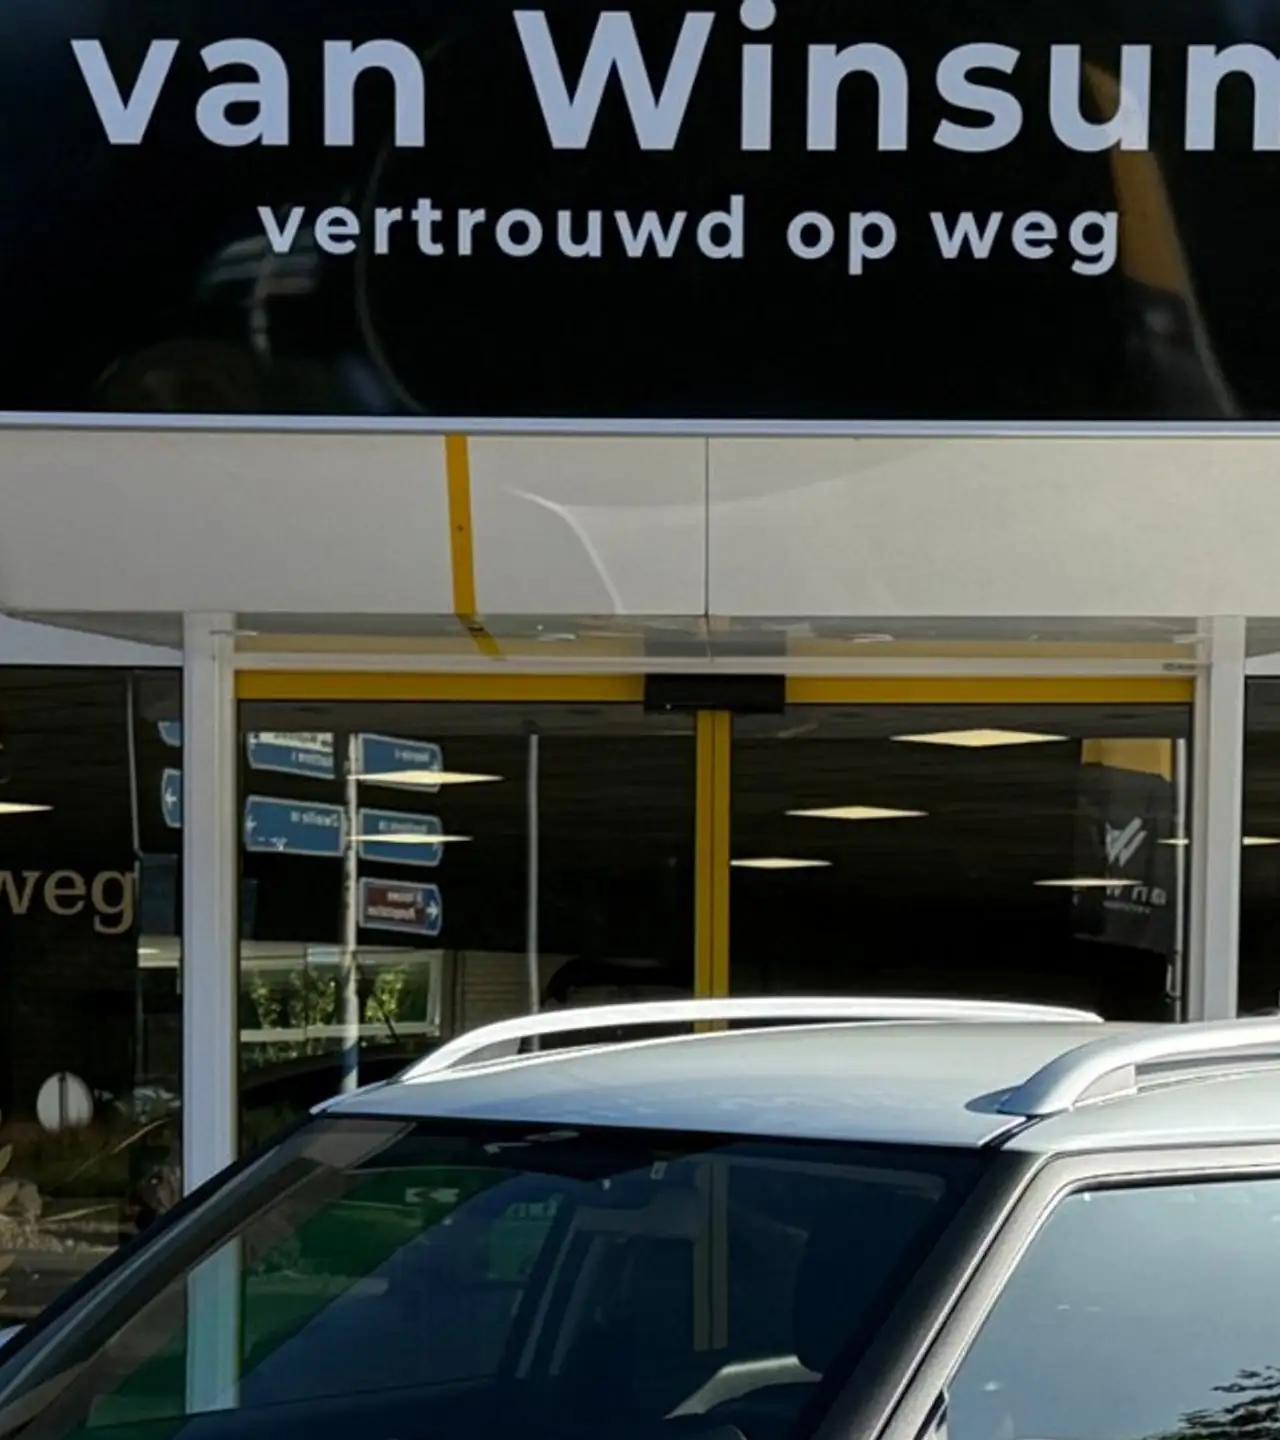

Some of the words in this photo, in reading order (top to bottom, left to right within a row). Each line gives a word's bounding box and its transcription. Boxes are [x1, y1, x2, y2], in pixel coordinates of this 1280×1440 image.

[70, 34, 426, 146] van
[257, 195, 745, 259] vertrouwd
[786, 208, 898, 274] op
[930, 208, 1121, 276] weg
